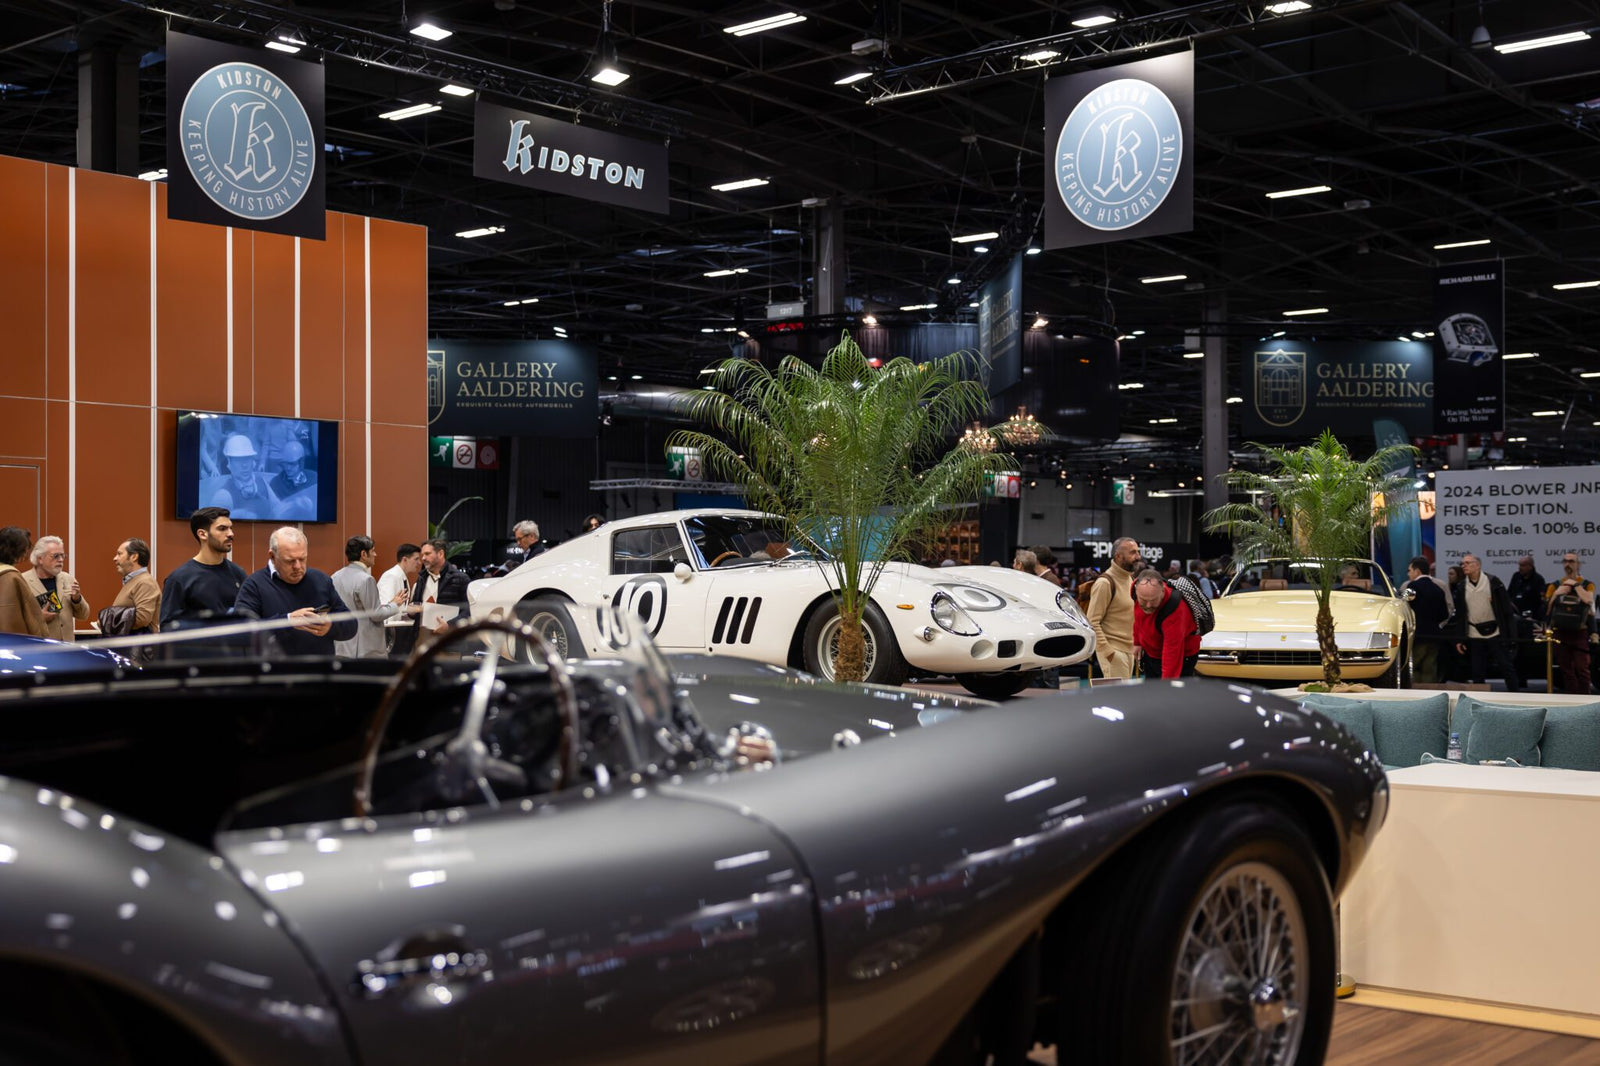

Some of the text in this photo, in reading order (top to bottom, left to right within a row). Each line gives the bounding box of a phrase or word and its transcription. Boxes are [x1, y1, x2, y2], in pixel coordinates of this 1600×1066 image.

[217, 70, 282, 100] KIDSTON
[1087, 87, 1150, 114] KIDSTON
[188, 119, 308, 212] KEEPING HISTORY ALIVE
[1061, 133, 1175, 223] KEEPING HISTORY ALIVE
[1439, 273, 1496, 285] RICHARD MILLE
[456, 361, 558, 379] GALLERY
[1316, 362, 1411, 379] GALLERY
[456, 381, 585, 398] AALDERING
[1316, 382, 1434, 398] AALDERING
[1444, 485, 1483, 498] 2024
[1489, 482, 1565, 497] BLOWER
[1444, 504, 1490, 517] FIRST
[1496, 502, 1573, 516] EDITION.
[1444, 523, 1479, 536] 85%
[1483, 523, 1527, 536] Scale.
[1532, 522, 1579, 535] 100%
[1486, 549, 1534, 557] ELECTRIC
